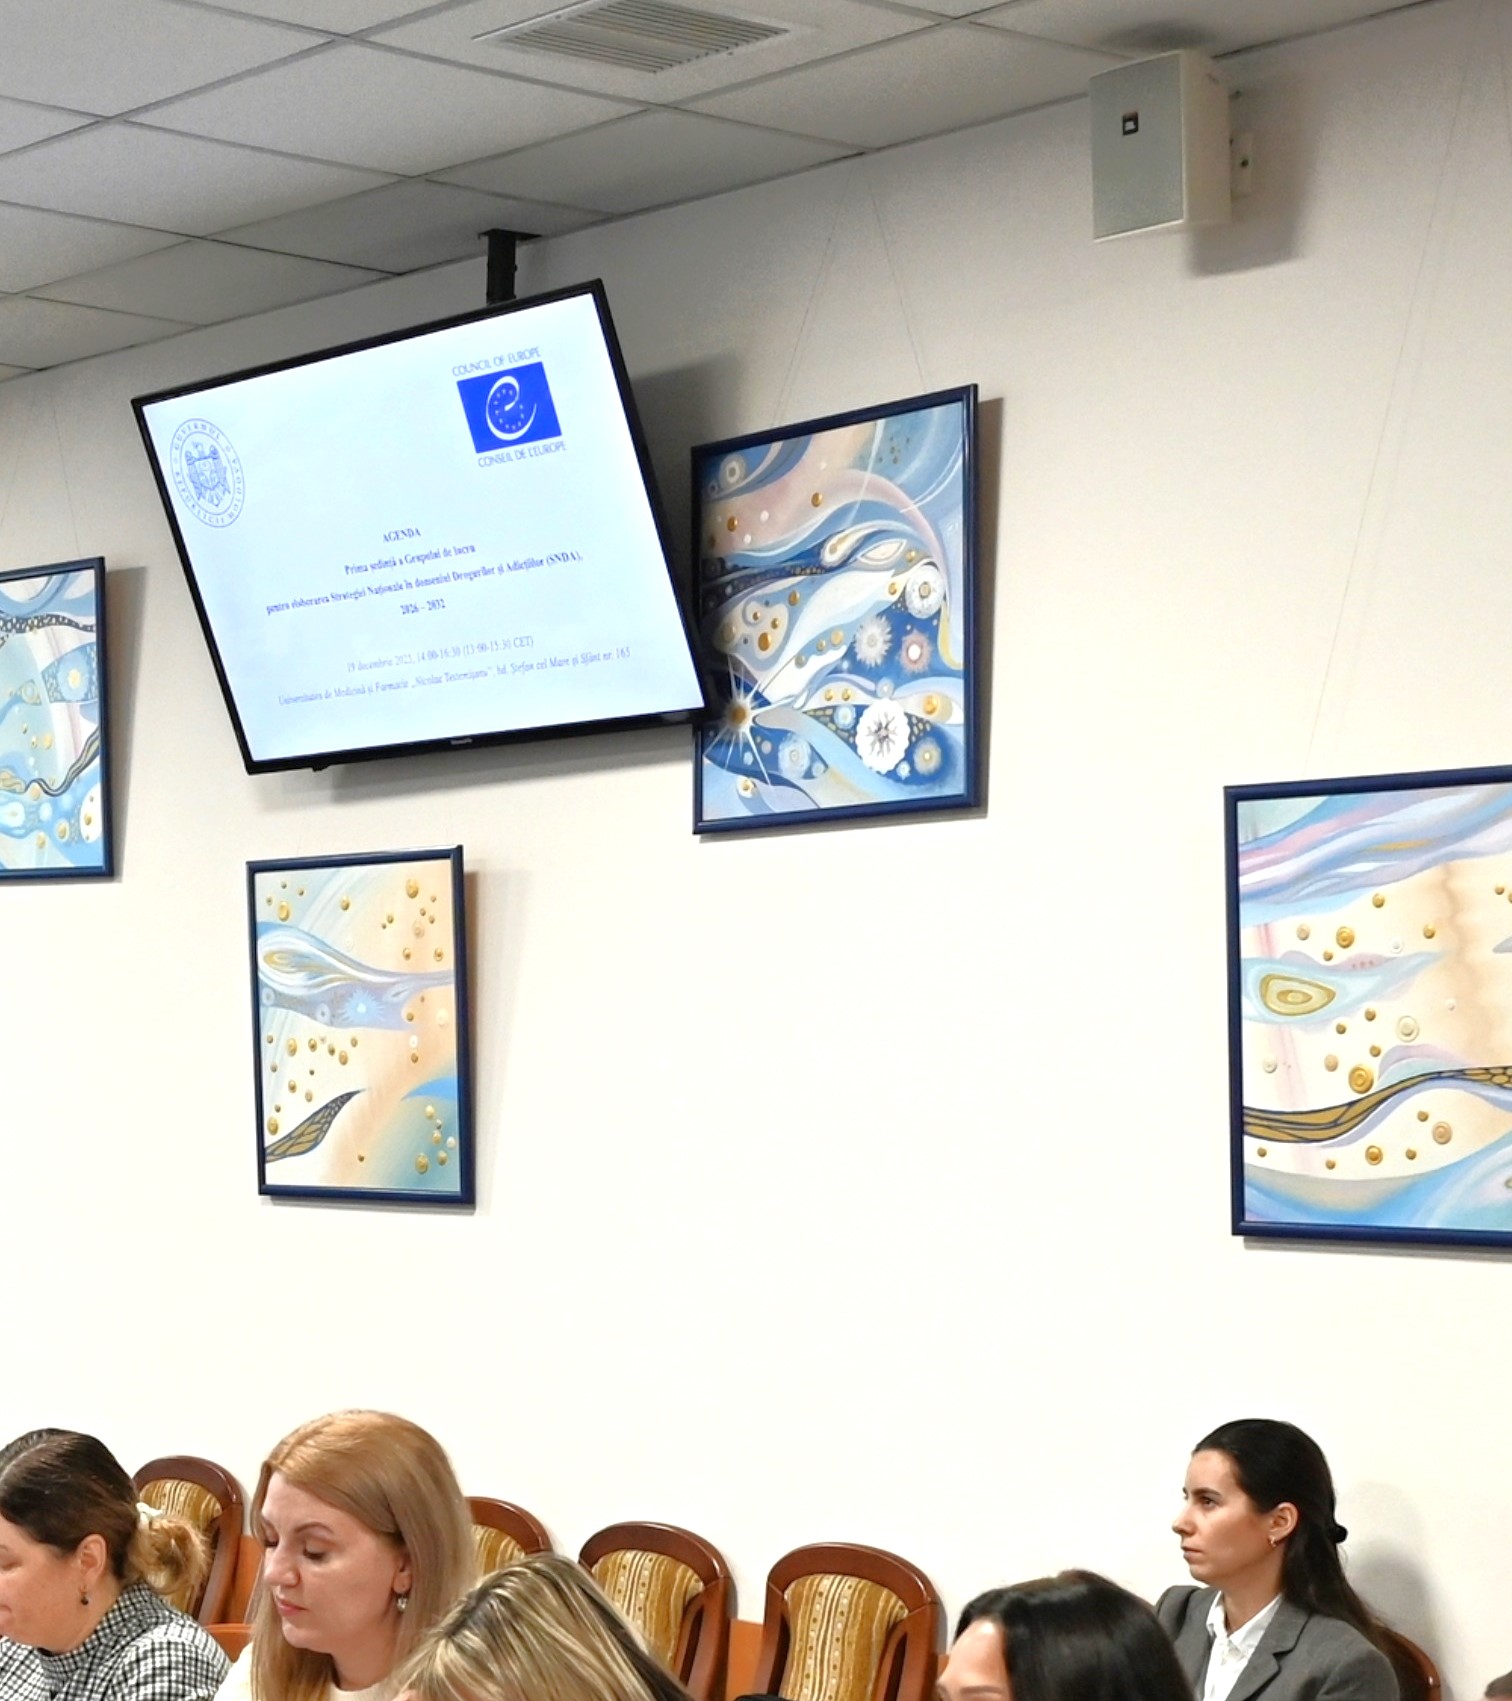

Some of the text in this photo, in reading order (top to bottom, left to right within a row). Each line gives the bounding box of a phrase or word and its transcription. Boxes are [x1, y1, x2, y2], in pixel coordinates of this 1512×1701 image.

[450, 346, 542, 378] COUNCIL OF EUROPE
[476, 451, 513, 468] CONSEIL
[513, 448, 527, 461] DE
[380, 525, 422, 543] AGENDA
